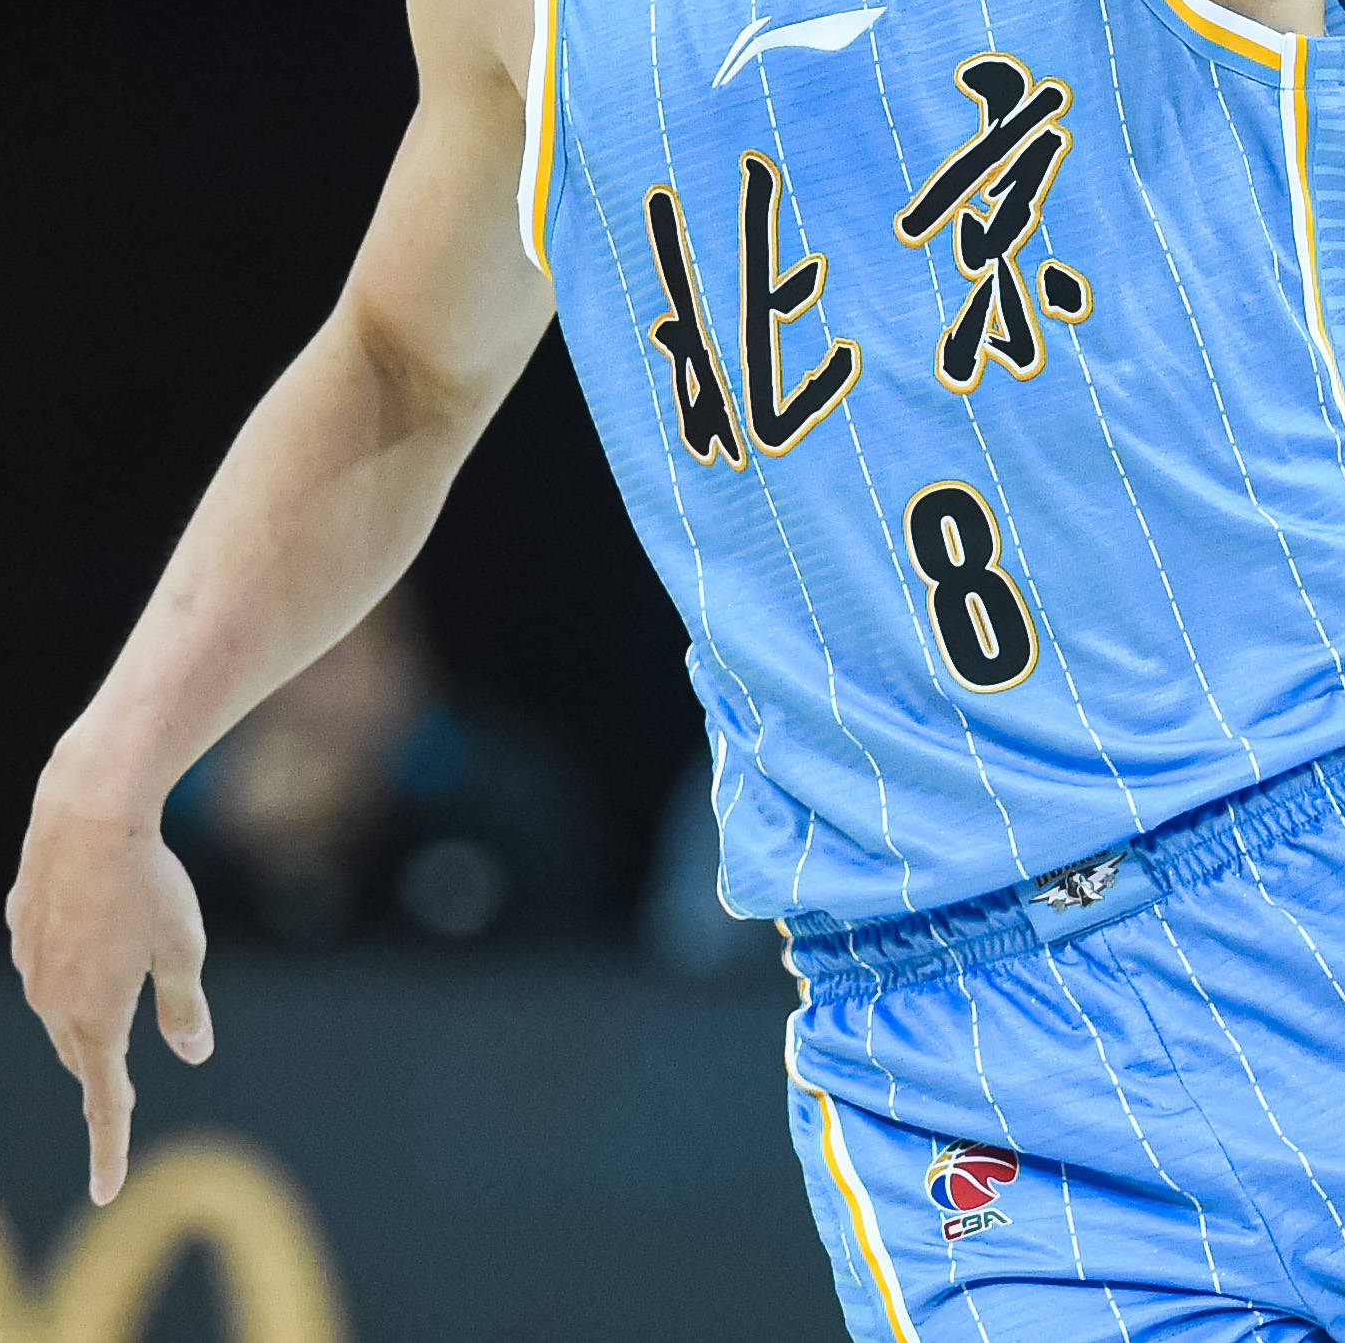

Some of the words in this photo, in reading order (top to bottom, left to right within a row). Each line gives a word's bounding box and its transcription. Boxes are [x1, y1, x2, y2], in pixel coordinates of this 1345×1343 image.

[643, 51, 1092, 473] 北京
[902, 479, 1039, 694] 8
[942, 1208, 1012, 1242] CBA
